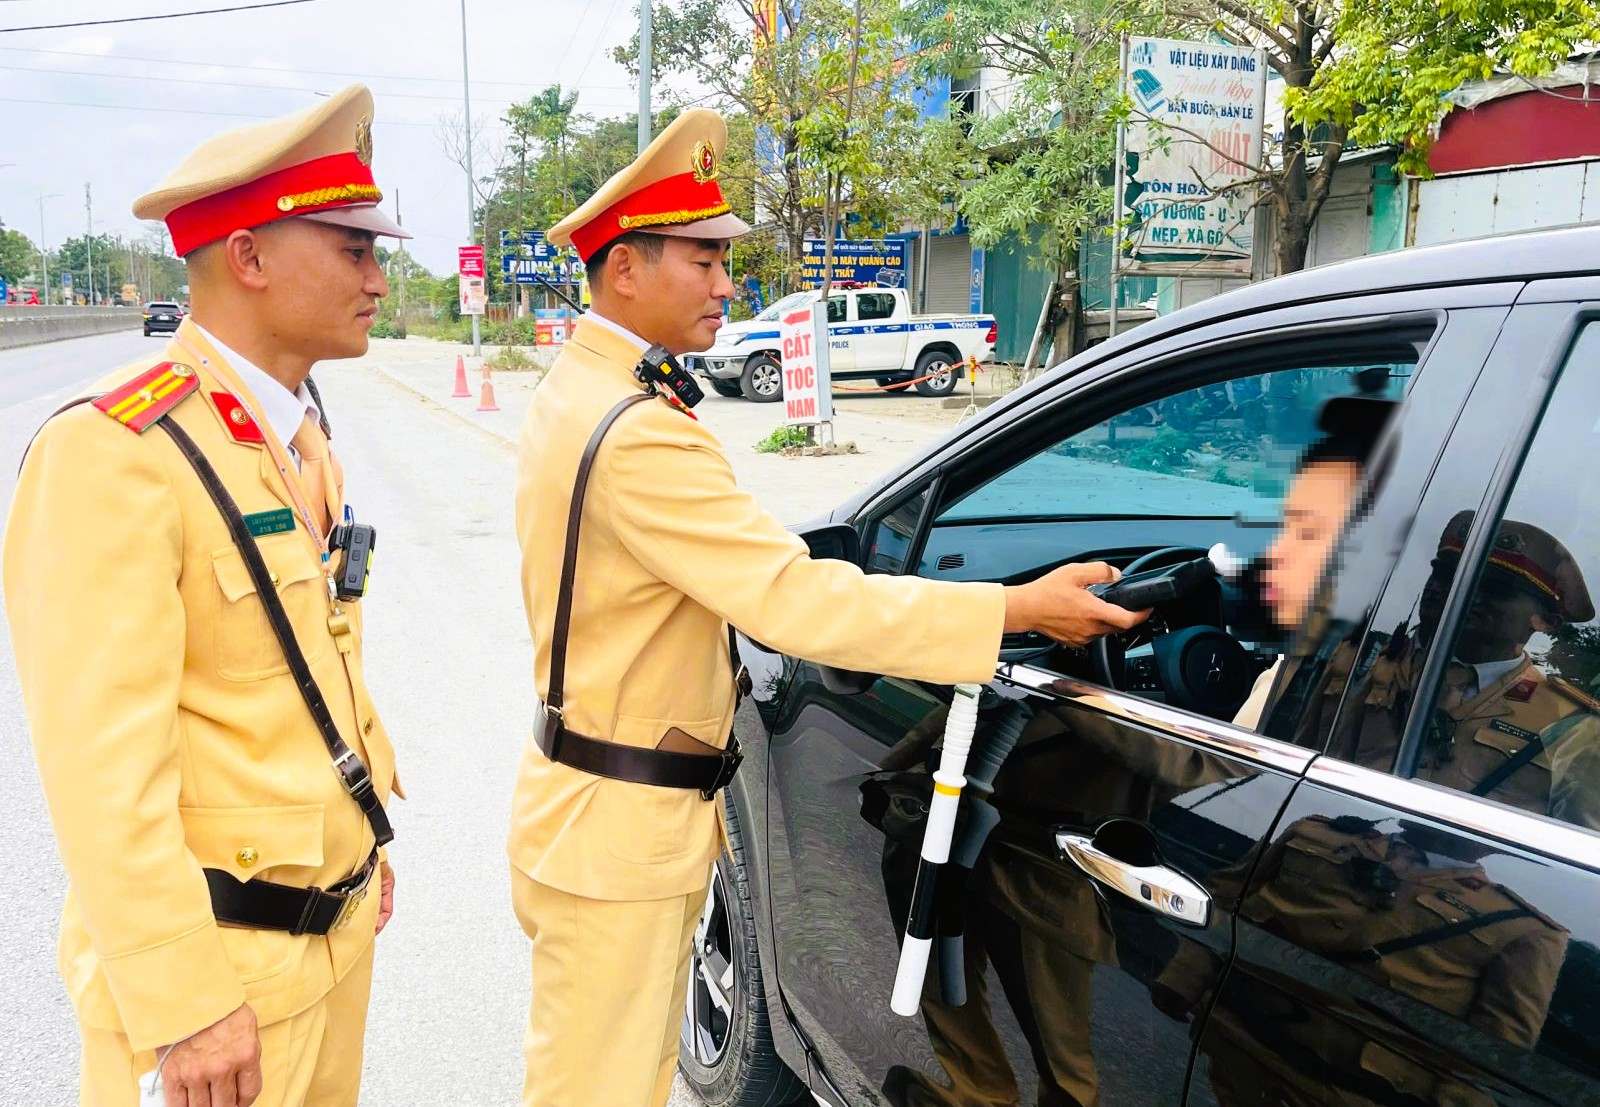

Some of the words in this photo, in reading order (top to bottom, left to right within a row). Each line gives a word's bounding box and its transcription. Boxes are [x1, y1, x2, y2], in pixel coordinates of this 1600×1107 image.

[1170, 48, 1187, 68] VẬT
[1189, 50, 1208, 70] LIỆU
[1211, 52, 1228, 70] XÂY
[1143, 179, 1172, 193] TÔN
[840, 255, 857, 266] MÁY
[859, 254, 885, 267] QUẢNG
[783, 330, 811, 360] CẮT
[832, 340, 849, 349] POLICE
[785, 364, 814, 391] TÓC
[787, 397, 815, 419] NAM
